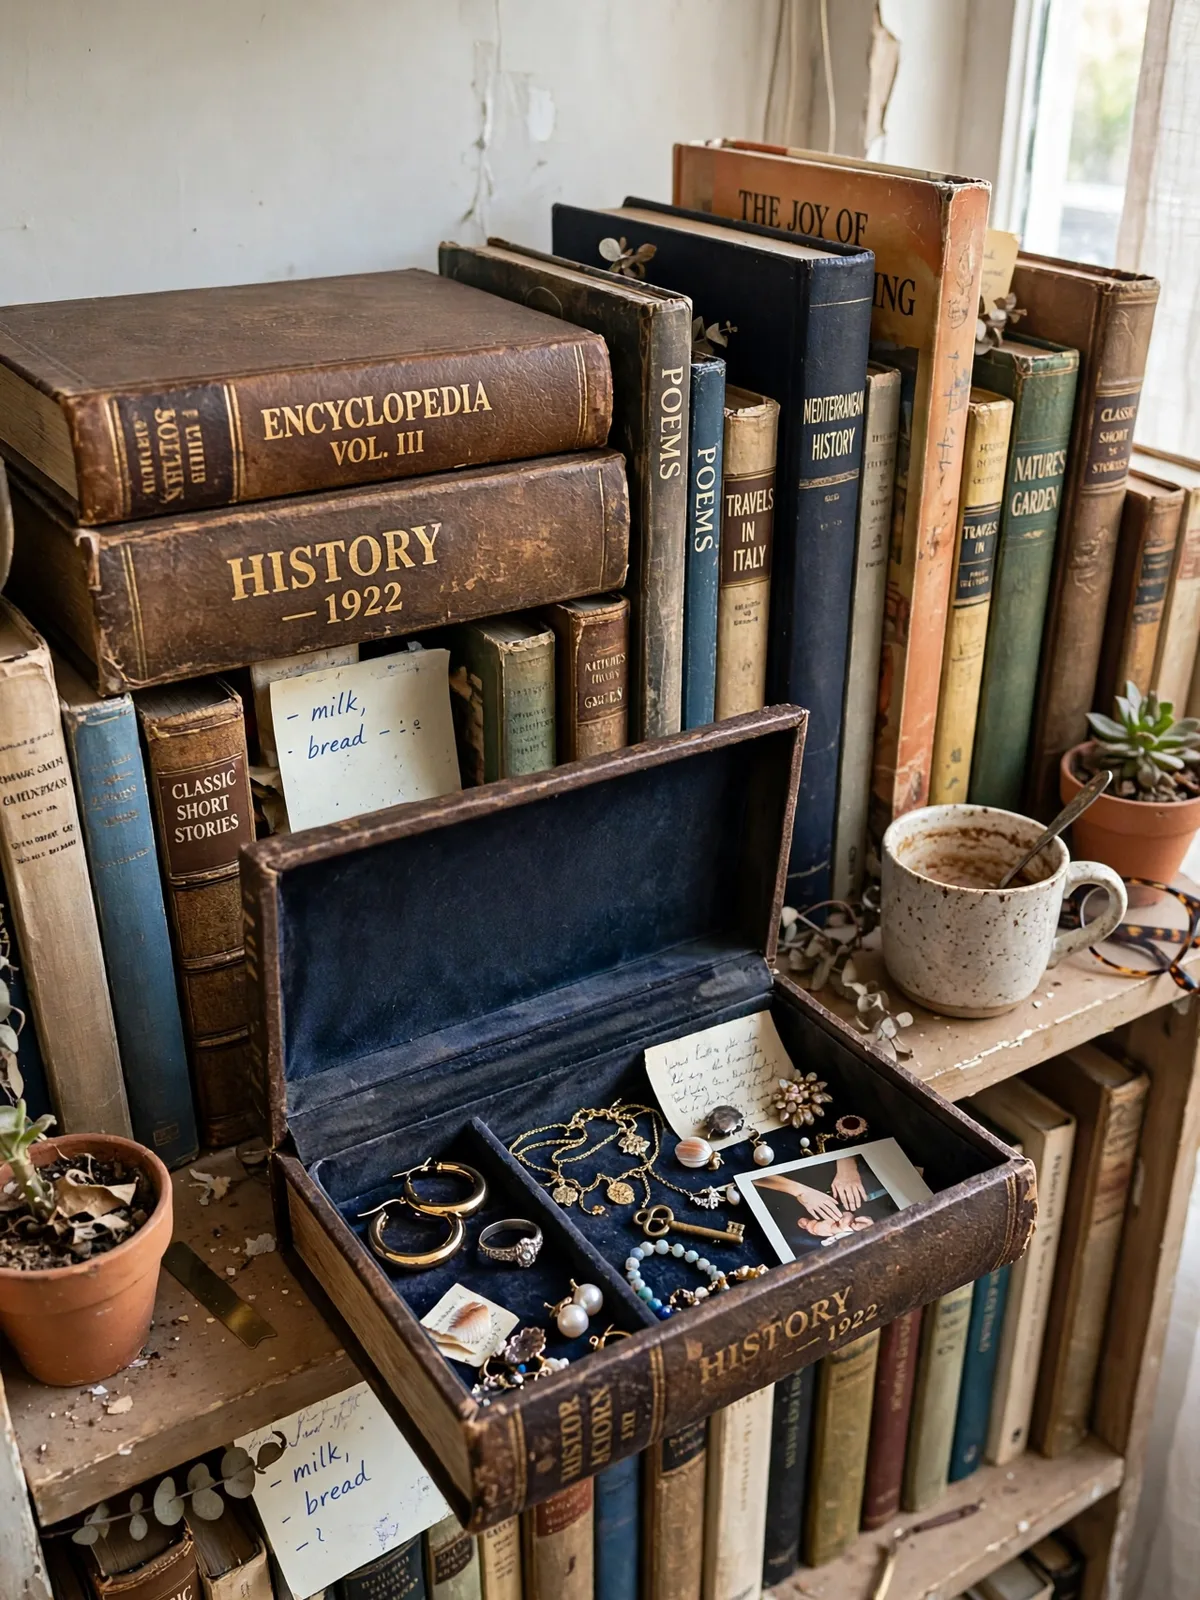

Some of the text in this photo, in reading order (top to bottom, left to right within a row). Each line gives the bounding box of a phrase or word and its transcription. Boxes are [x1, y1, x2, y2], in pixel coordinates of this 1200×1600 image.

[738, 189, 869, 246] THE JOY OF
[872, 272, 916, 317] ING
[260, 379, 493, 441] ENCYCLOPEDIA
[660, 365, 684, 481] POEMS
[803, 389, 865, 425] MEDITERRANEAN
[329, 429, 425, 467] VOL. III
[811, 426, 857, 461] HISTORY
[694, 445, 717, 553] POEMS
[725, 487, 774, 517] TRAVELS
[1010, 484, 1061, 517] GARDEN
[741, 520, 756, 544] IN
[974, 540, 986, 555] IN
[226, 522, 443, 602] HISTORY
[732, 544, 767, 572] ITALY
[324, 581, 404, 625] 1922
[310, 689, 366, 722] milk,
[307, 723, 368, 760] bread
[171, 769, 237, 800] CLASSIC
[176, 794, 230, 822] SHORT
[174, 813, 240, 844] STORIES
[700, 1285, 853, 1385] HISTORY
[827, 1302, 878, 1342] 1922
[293, 1441, 350, 1484] milk,
[304, 1458, 372, 1516] bread
